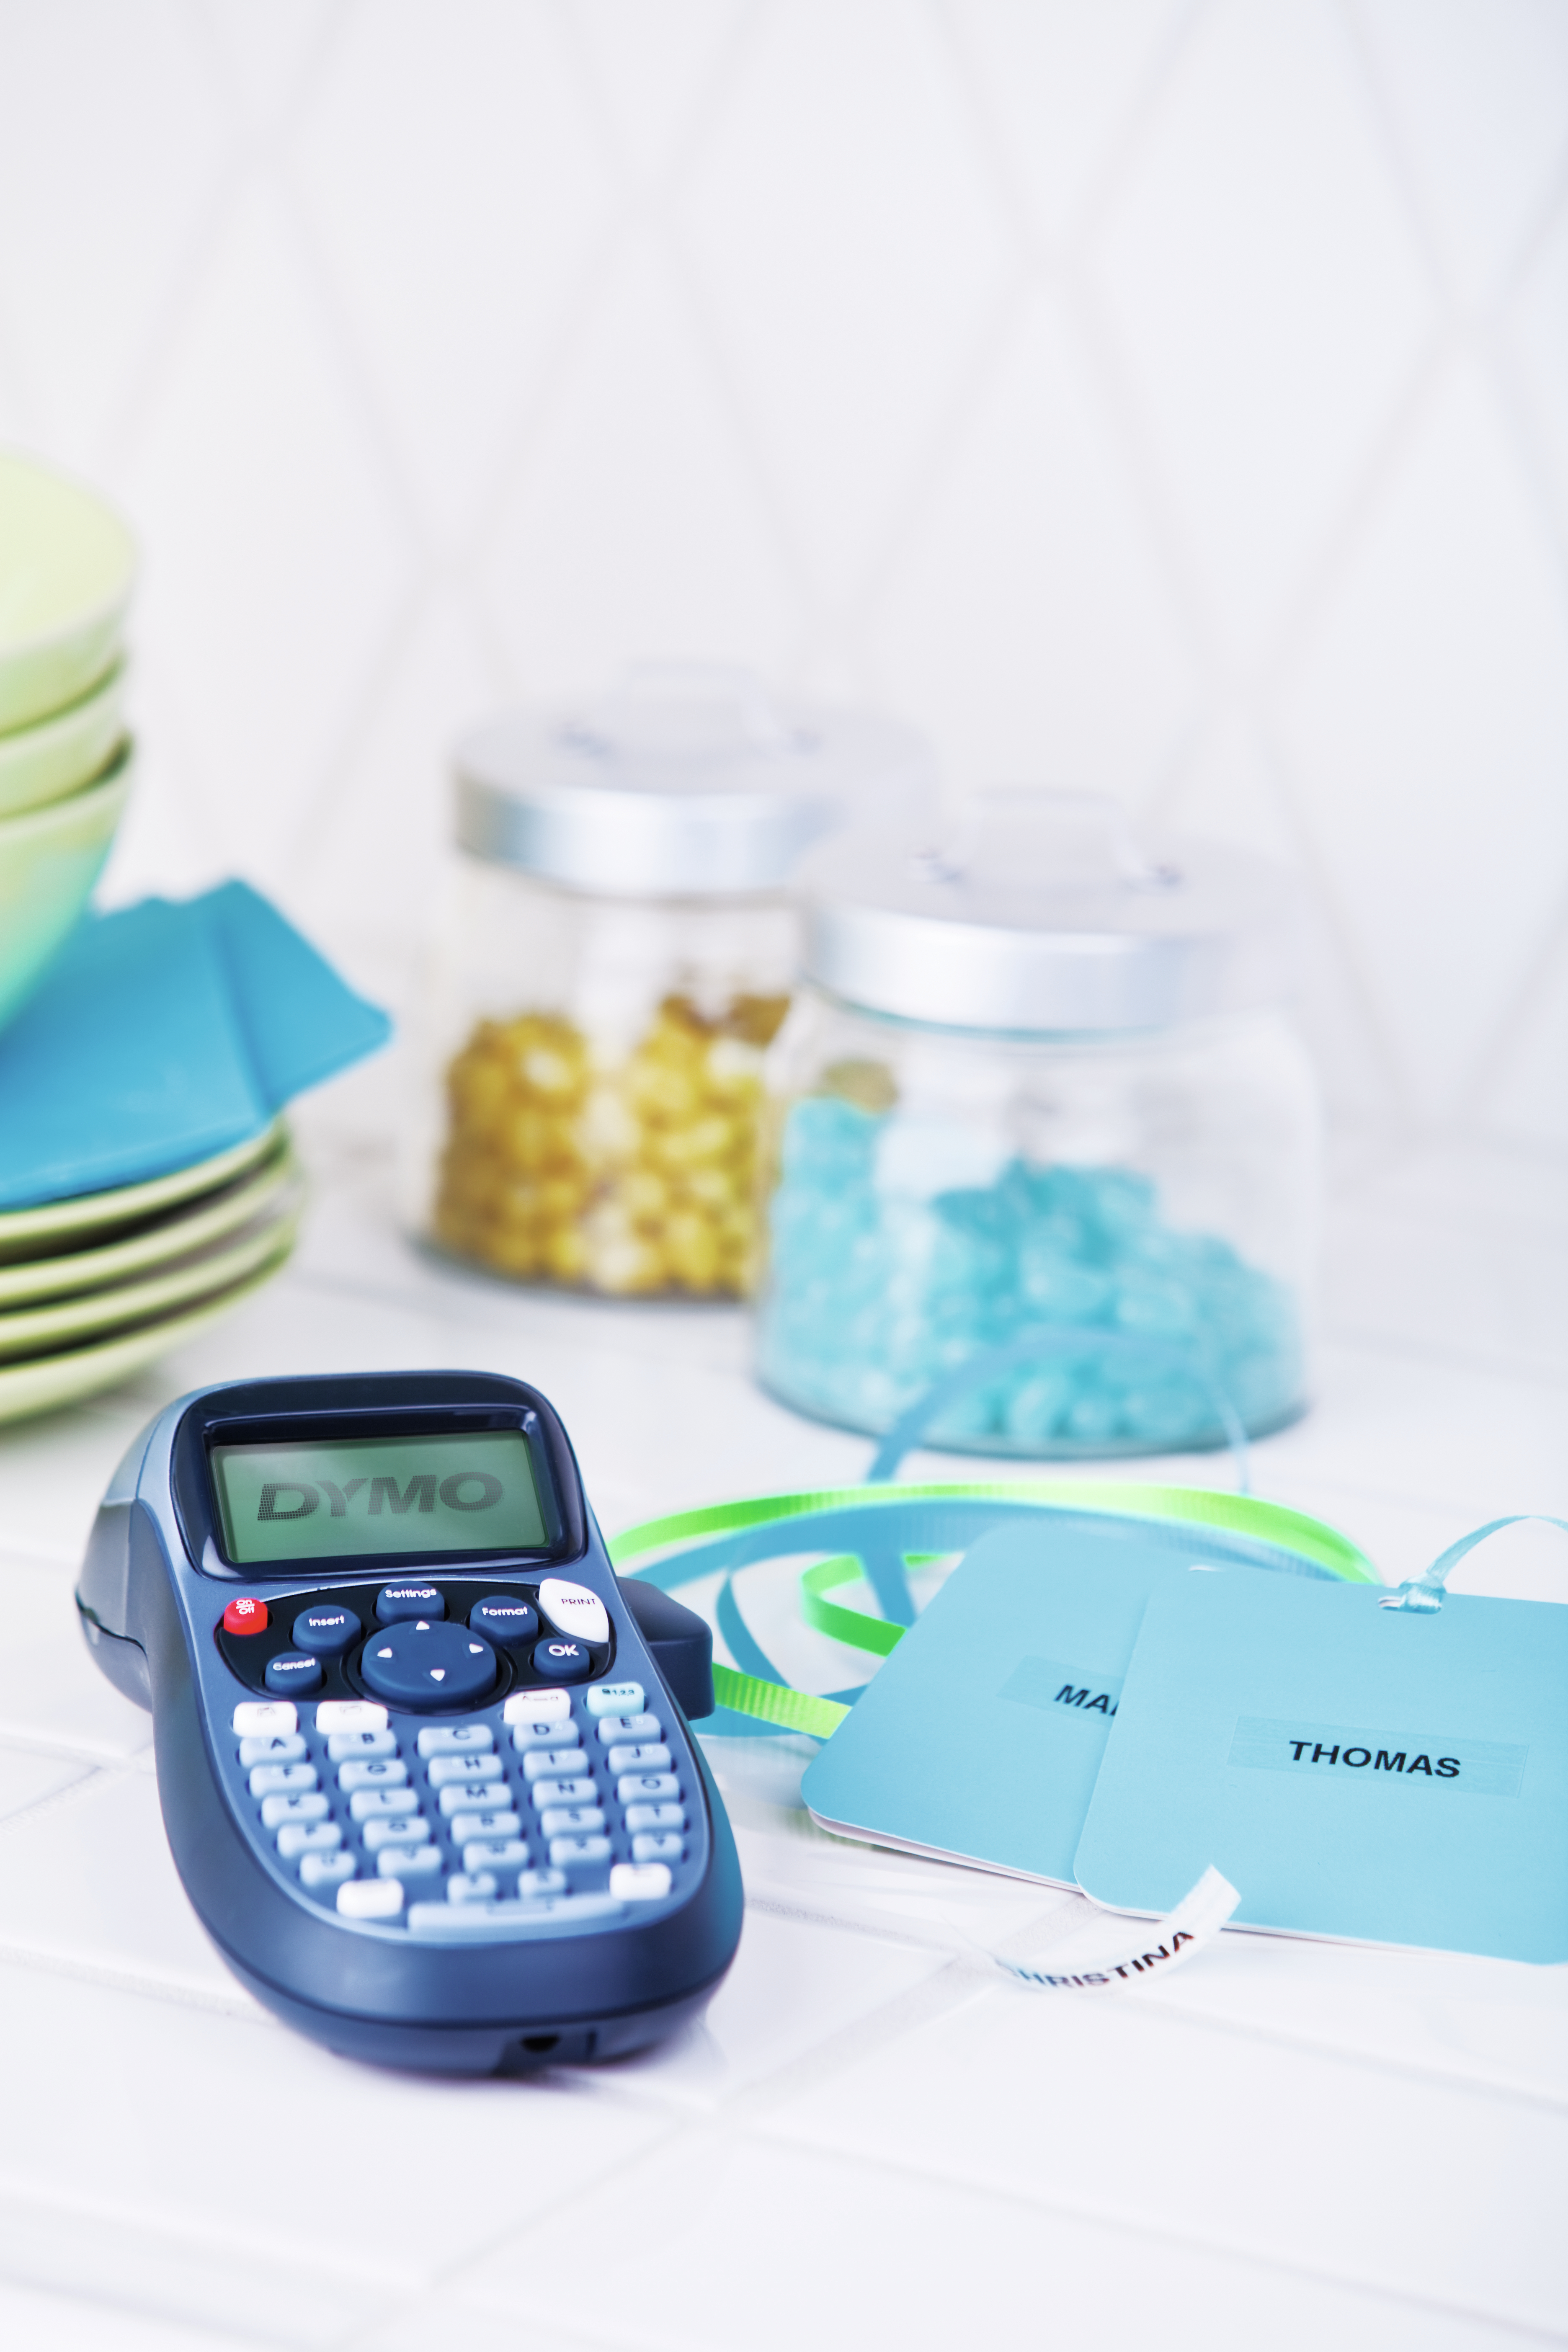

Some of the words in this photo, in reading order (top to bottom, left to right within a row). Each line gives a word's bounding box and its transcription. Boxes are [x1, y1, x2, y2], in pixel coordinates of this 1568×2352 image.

[257, 1472, 504, 1521] DYMO
[385, 1589, 437, 1598] Settings
[482, 1607, 528, 1616] Format
[309, 1615, 345, 1626] Insert
[549, 1645, 579, 1656] OK
[273, 1658, 315, 1670] Cancel
[620, 1718, 632, 1729] E
[452, 1729, 470, 1740] C
[532, 1724, 549, 1736] D
[271, 1738, 286, 1750] A
[361, 1733, 374, 1744] B
[1289, 1741, 1461, 1778] THOMAS
